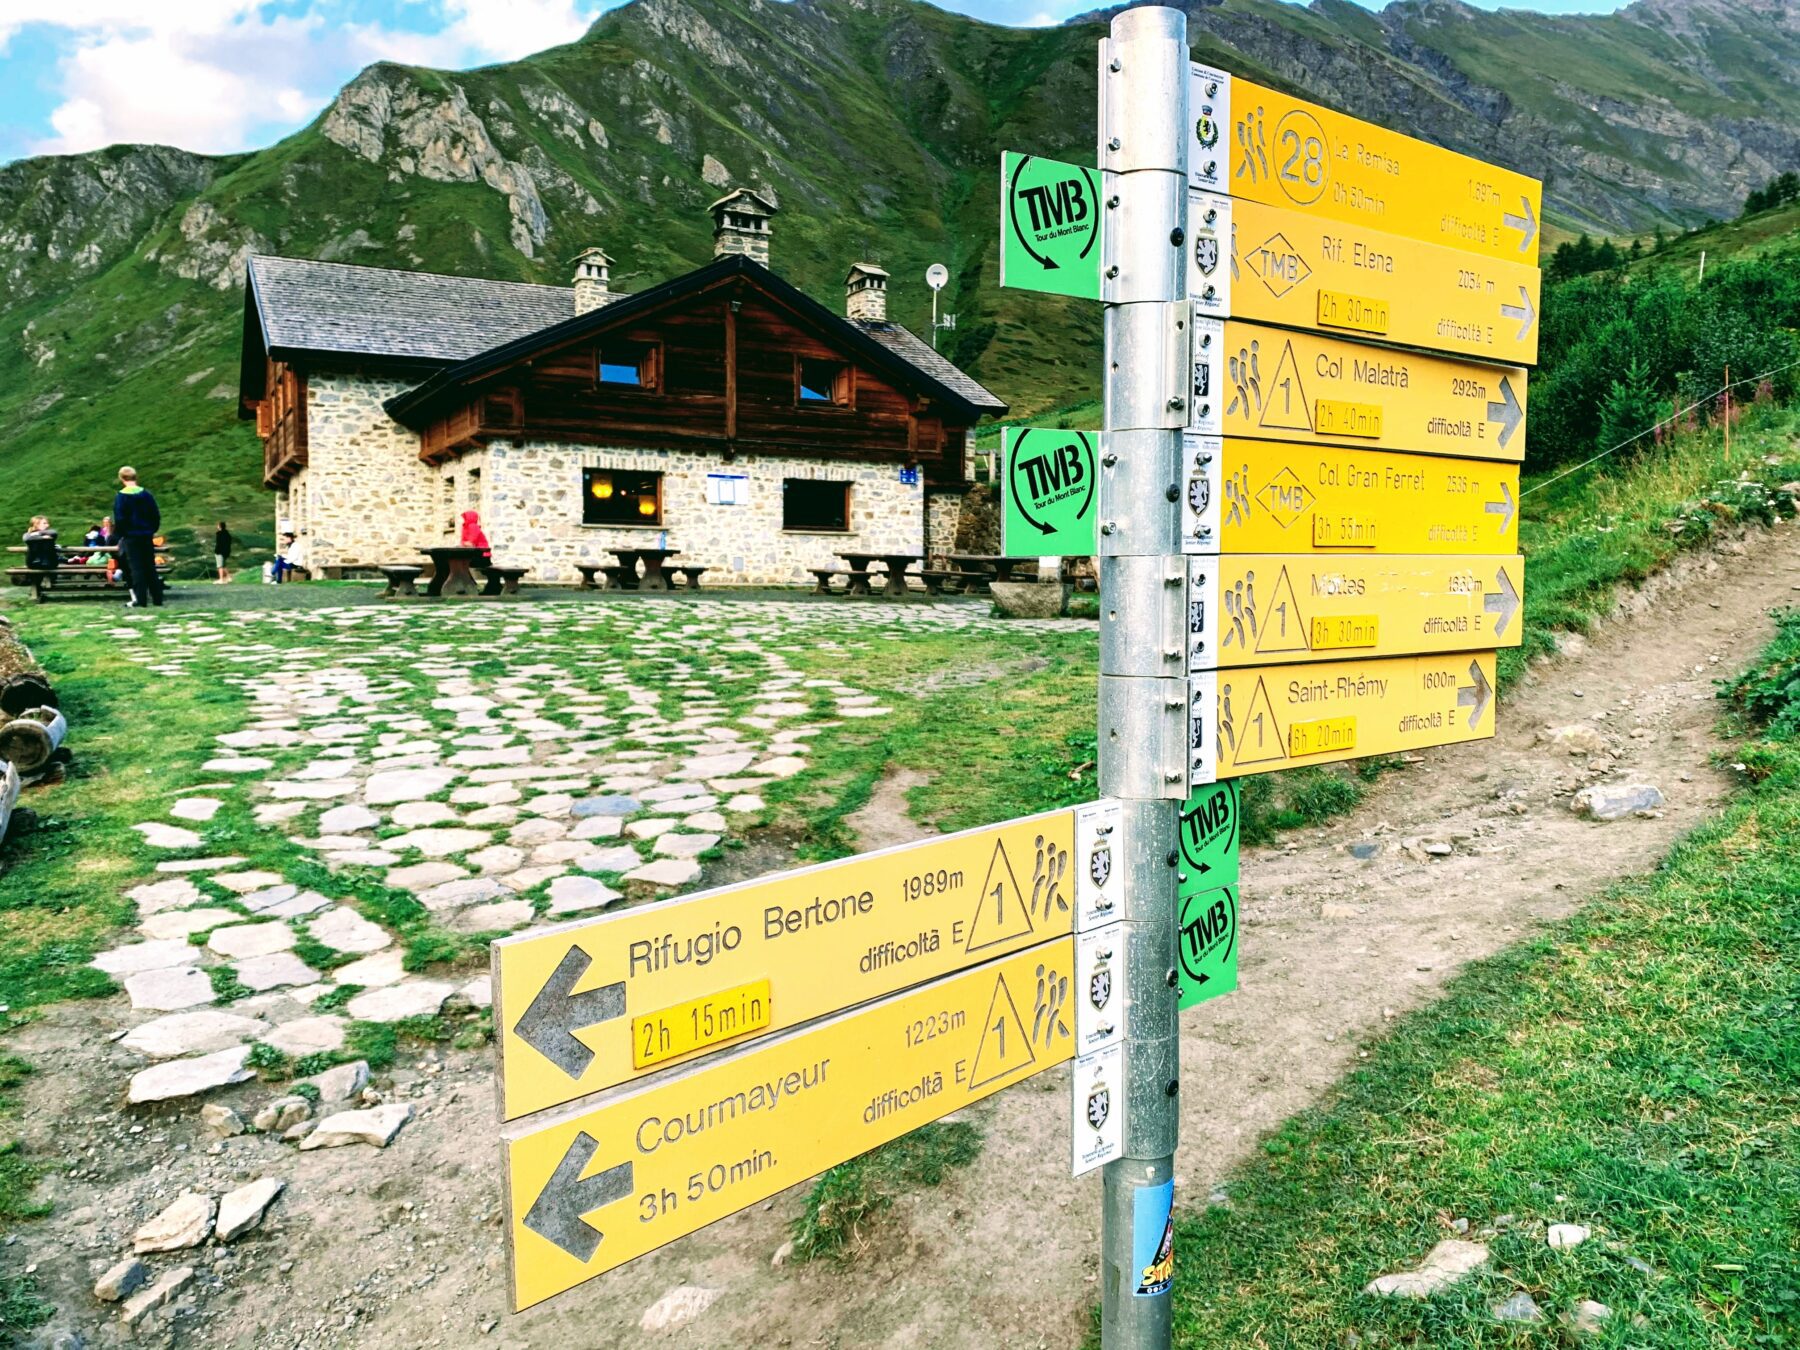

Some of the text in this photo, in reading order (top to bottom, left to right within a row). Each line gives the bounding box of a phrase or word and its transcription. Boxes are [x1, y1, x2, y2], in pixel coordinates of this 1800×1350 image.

[1281, 129, 1323, 187] 28
[1334, 135, 1400, 176] La Remisa
[1018, 179, 1088, 232] TMB
[1035, 224, 1090, 242] Tour du Mont Blanc
[1493, 227, 1500, 246] E
[1260, 249, 1298, 281] TMB
[1322, 235, 1394, 273] Rif. Elena
[1458, 269, 1495, 294] 2054 m
[1322, 294, 1386, 327] 2h 30min
[1437, 318, 1494, 345] difficoltà E
[1316, 353, 1409, 389] Col Malatrà
[1279, 377, 1291, 415] 1
[1452, 378, 1487, 400] 2925m
[1320, 404, 1380, 433] 2h 40min
[1427, 417, 1485, 439] difficoltà E
[1018, 444, 1084, 500] TMB
[1318, 462, 1425, 492] Col Gran Ferret
[1471, 481, 1480, 494] m
[1270, 485, 1304, 512] TMB
[1318, 516, 1377, 540] 3h 55min
[1472, 525, 1479, 541] E
[1311, 572, 1366, 597] Mottes
[1275, 601, 1286, 638] 1
[1315, 619, 1376, 644] 3h 30min
[1423, 615, 1482, 635] difficoltà E
[1287, 671, 1389, 705] Saint-Rhémy
[1422, 673, 1457, 691] 1600m
[1252, 712, 1264, 748] 1
[1293, 722, 1354, 752] 6h 20min
[1398, 709, 1456, 734] difficoltà E
[1183, 790, 1230, 846] TMB
[902, 869, 965, 903] 1989m
[989, 881, 1003, 926] 1
[628, 890, 875, 979] Rifugio Bertone
[1183, 900, 1228, 958] TMB
[859, 920, 965, 975] difficoltà E
[642, 993, 762, 1059] 2h 15min
[904, 1009, 967, 1049] 1223m
[991, 1015, 1005, 1060] 1
[635, 1058, 831, 1155] Courmayeur
[862, 1058, 967, 1126] difficoltà E
[638, 1148, 778, 1224] 3h 50min.
[1142, 1259, 1173, 1285] STA
